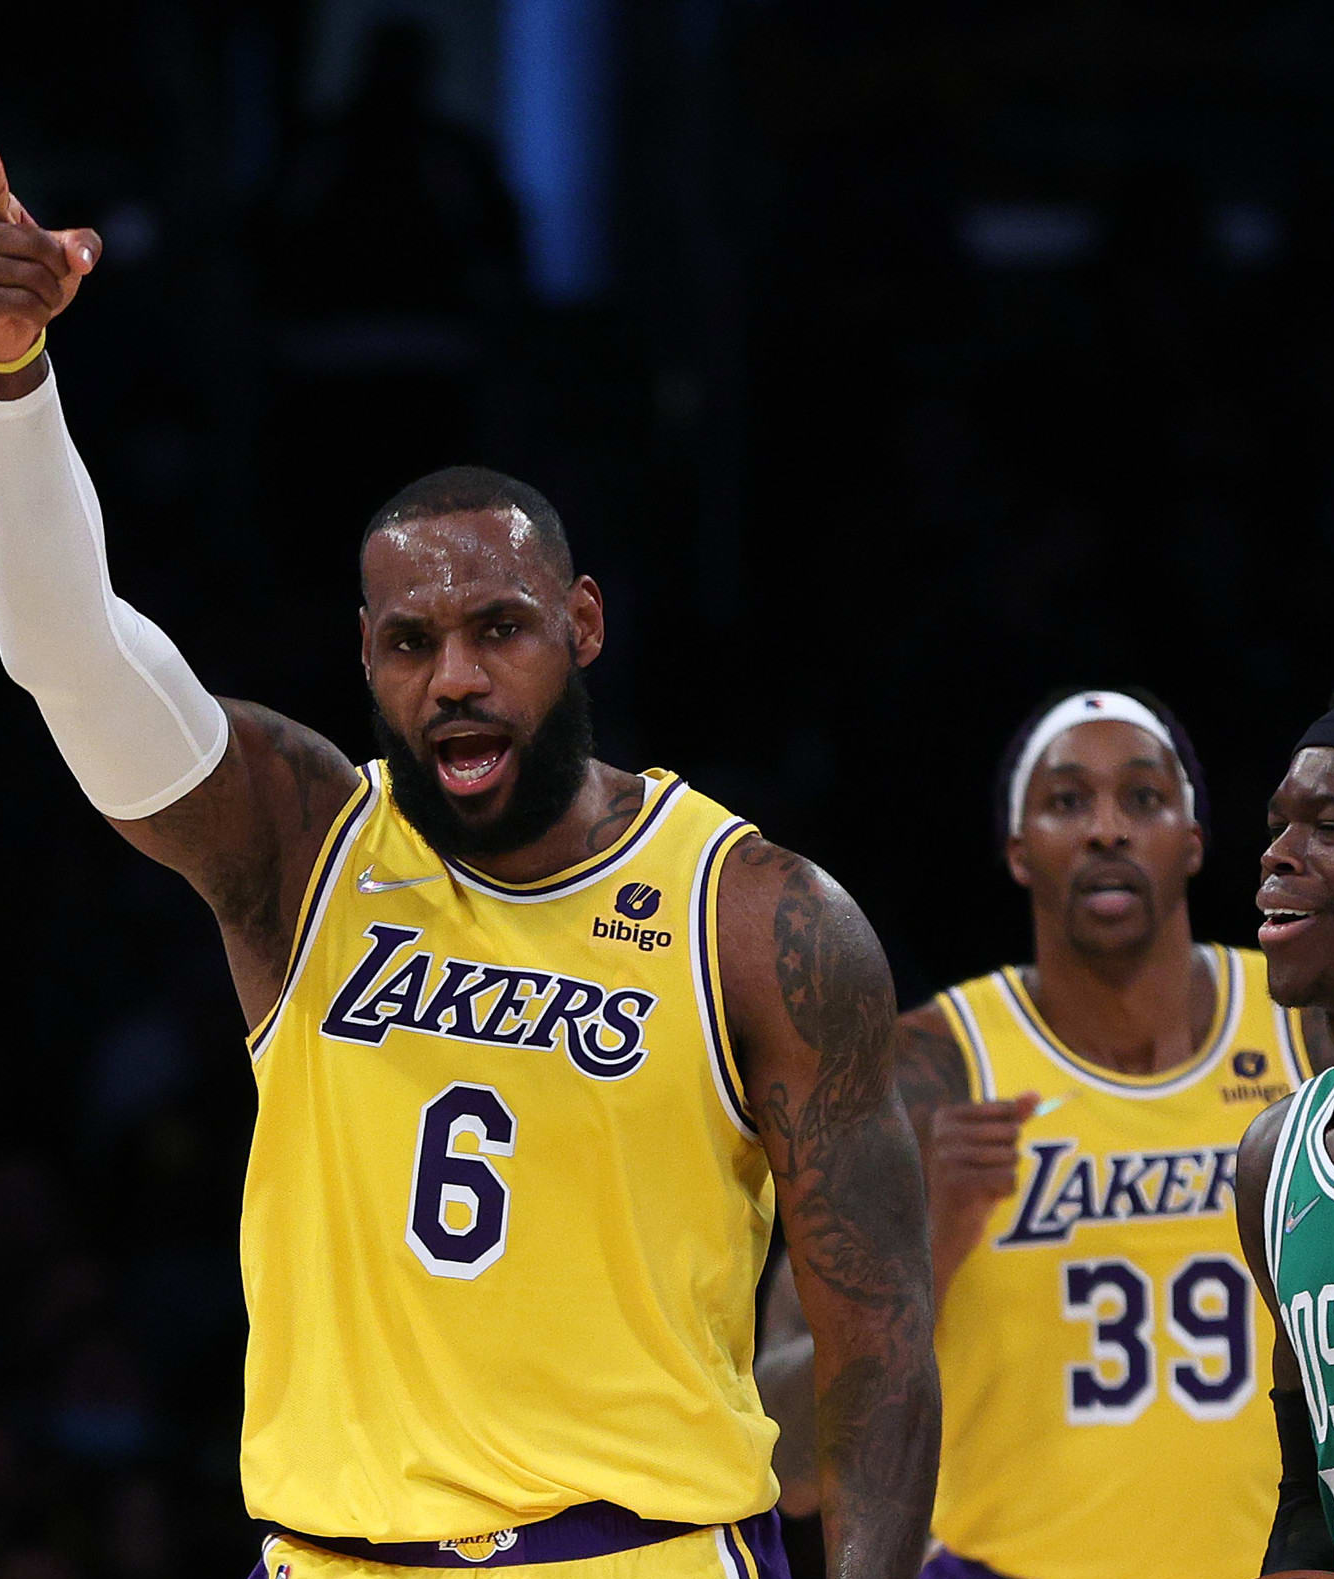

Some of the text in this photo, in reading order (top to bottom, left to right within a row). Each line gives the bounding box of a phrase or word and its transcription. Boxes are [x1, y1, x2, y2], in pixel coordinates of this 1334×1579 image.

[319, 920, 660, 1082] LAKERS
[592, 917, 673, 951] bibigo
[404, 1080, 518, 1280] 6
[1060, 1252, 1257, 1427] 39
